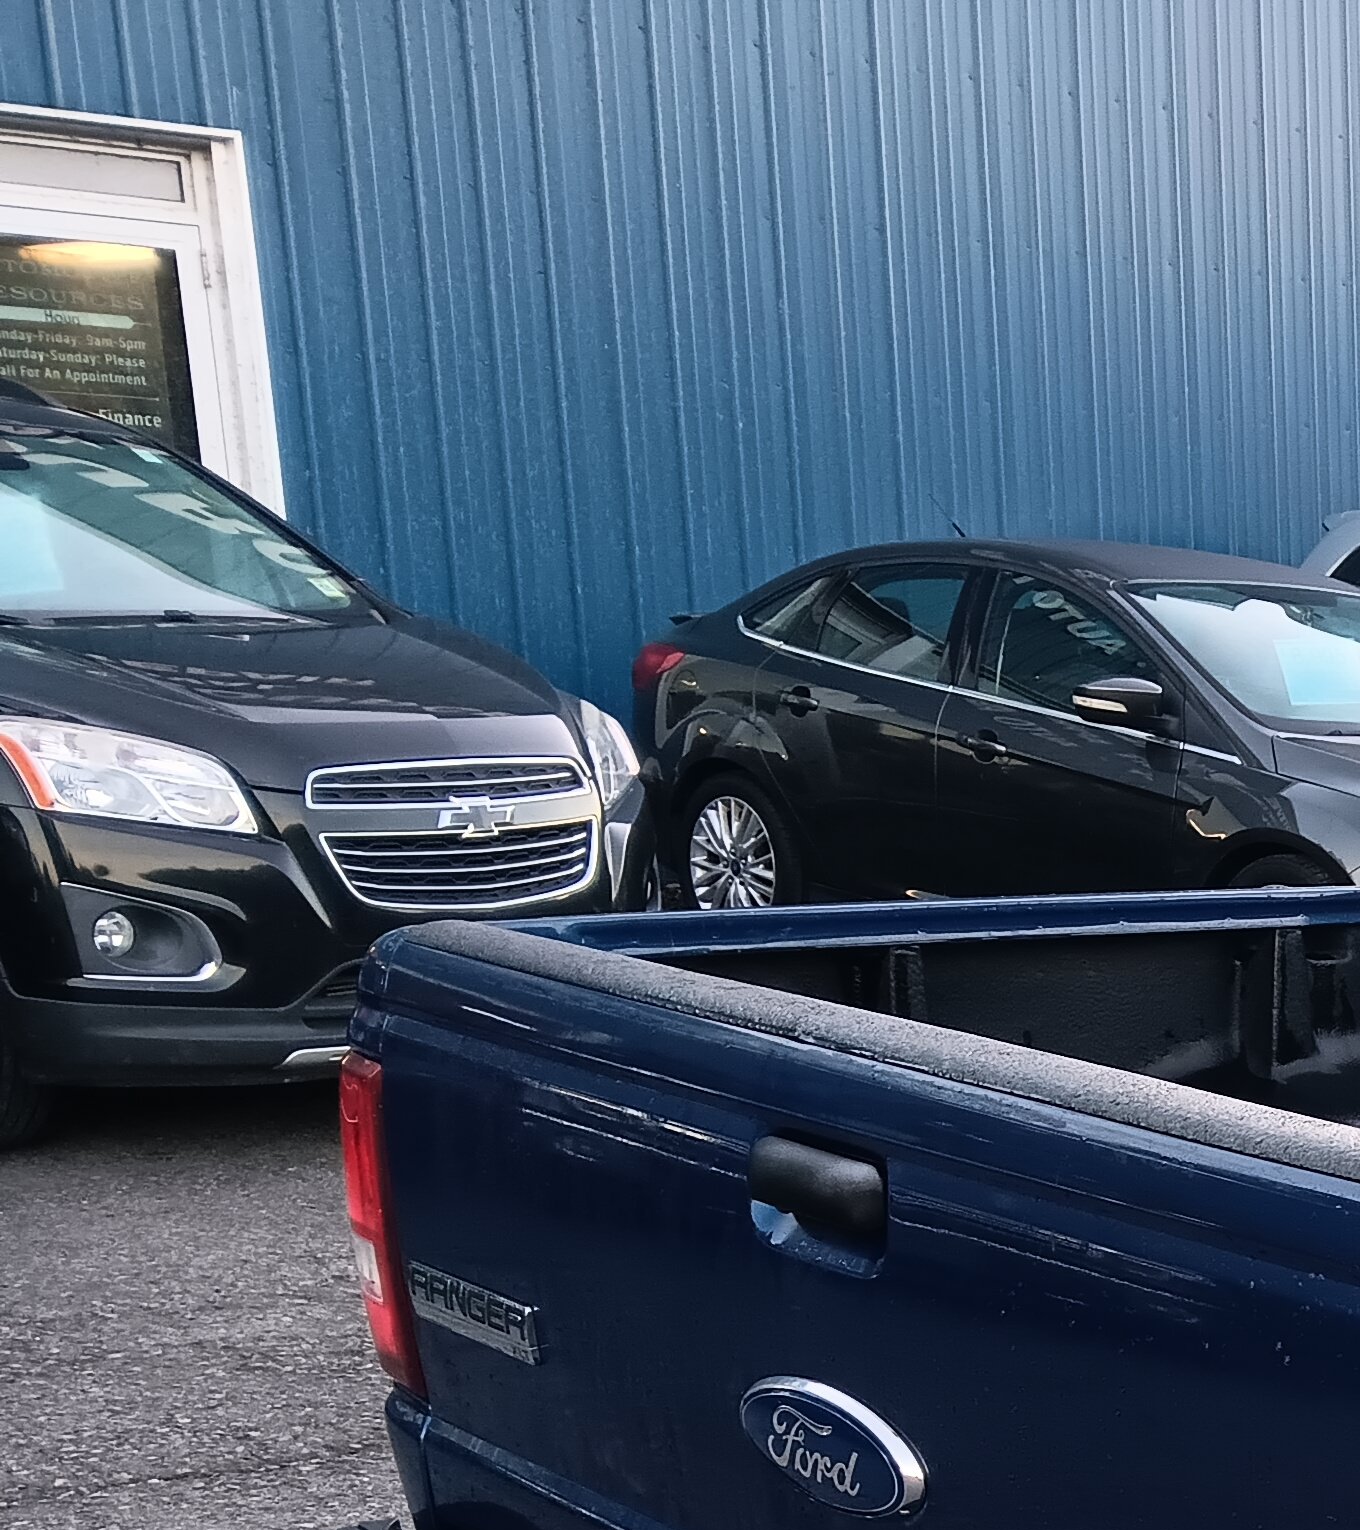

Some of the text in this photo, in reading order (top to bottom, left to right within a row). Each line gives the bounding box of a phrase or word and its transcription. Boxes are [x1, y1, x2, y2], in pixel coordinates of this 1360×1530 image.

[86, 334, 147, 350] 9am-5pm
[104, 354, 146, 368] Please
[0, 365, 147, 386] all For An Appointment
[98, 409, 162, 427] Finance
[410, 1267, 527, 1342] RANGER
[768, 1404, 861, 1498] Ford
